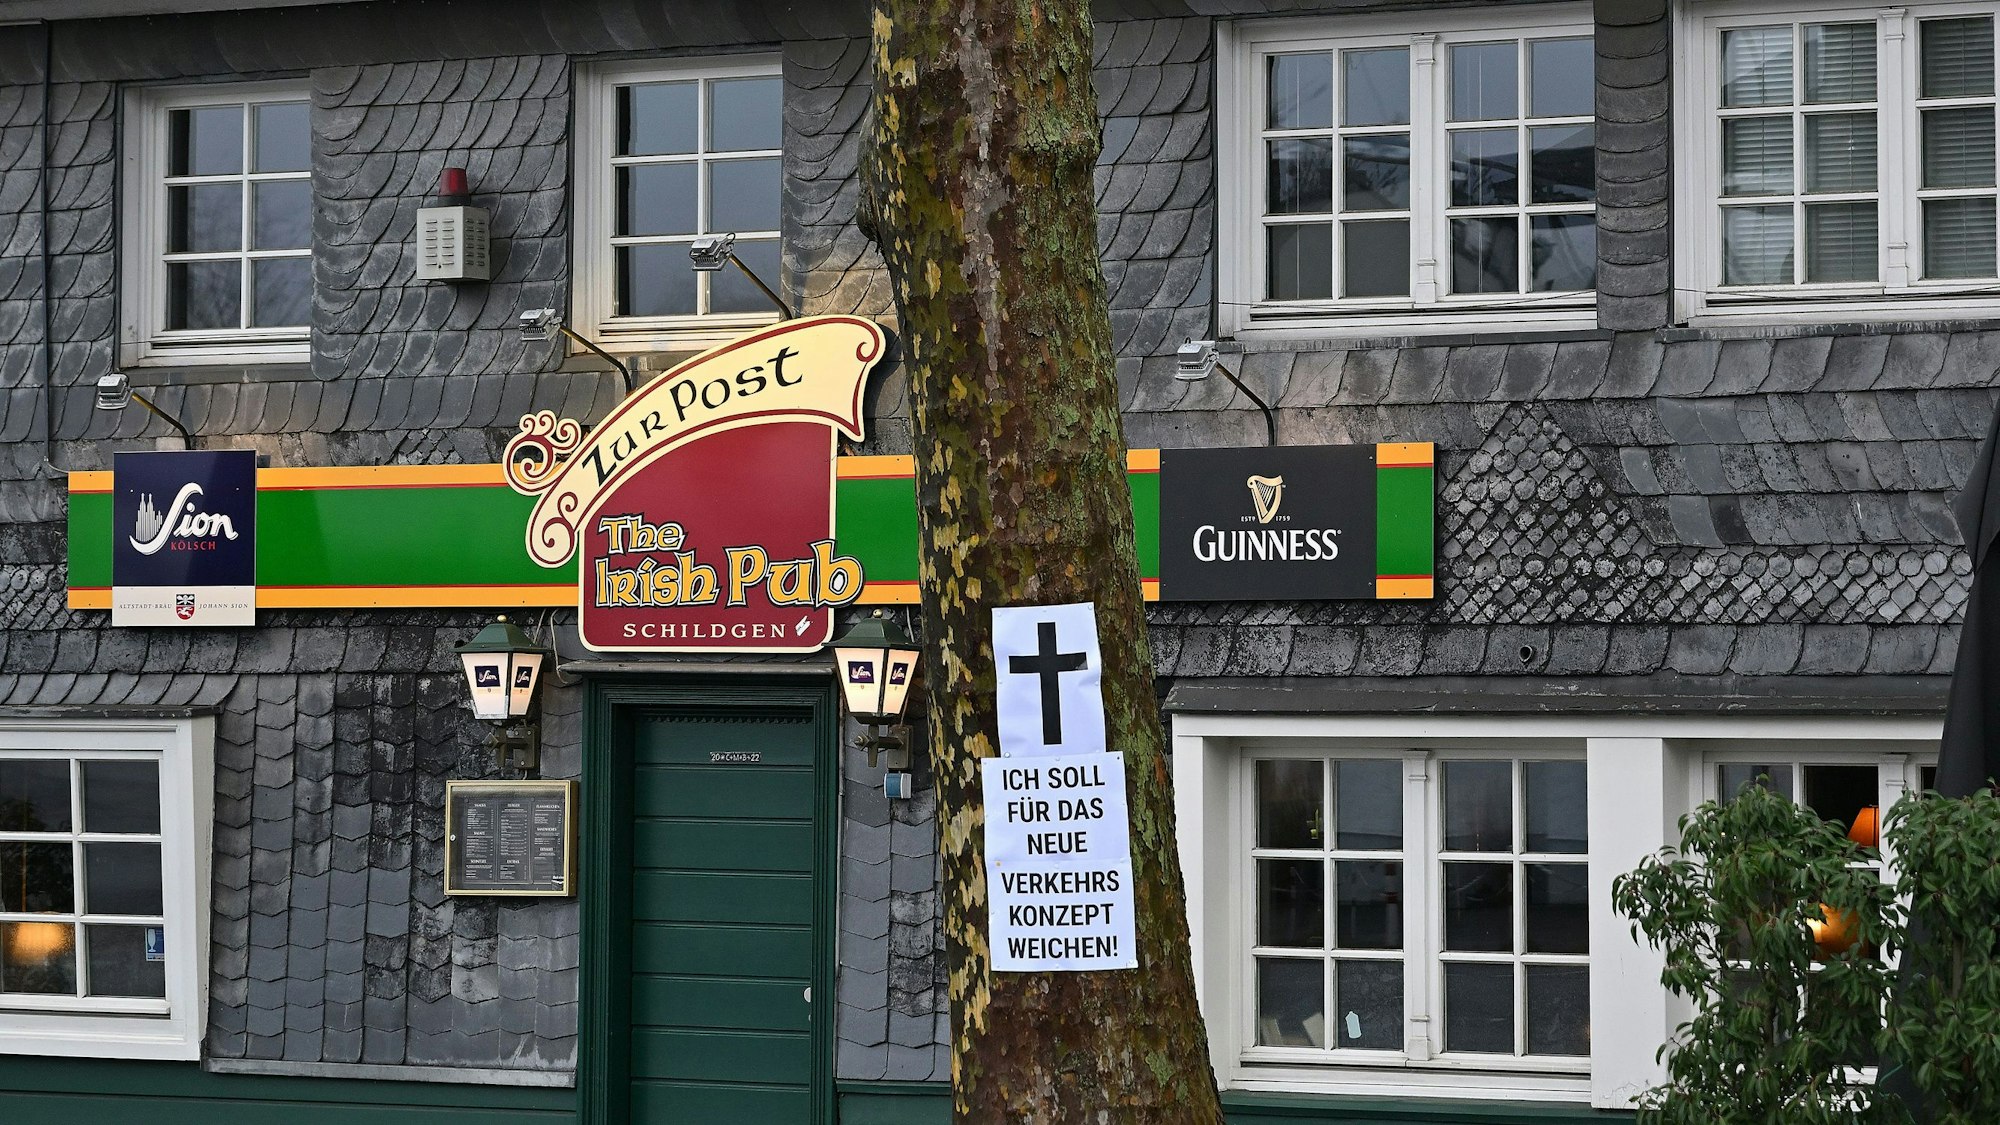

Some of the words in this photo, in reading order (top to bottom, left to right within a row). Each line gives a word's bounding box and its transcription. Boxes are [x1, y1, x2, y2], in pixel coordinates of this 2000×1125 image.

[129, 482, 239, 555] Sion
[170, 540, 216, 551] KÖLSCH
[599, 514, 685, 554] The
[595, 552, 719, 608] Irish
[726, 540, 865, 608] Pub
[623, 623, 785, 638] SCHILDGEN
[1002, 768, 1040, 790] ICH
[1048, 765, 1105, 789] SOLL
[1007, 796, 1051, 823] FÜR
[1058, 797, 1104, 821] DAS
[1027, 831, 1088, 855] NEUE
[1001, 870, 1120, 894] VERKEHRS
[1009, 903, 1114, 927] KONZEPT
[1007, 935, 1119, 959] WEICHEN!
